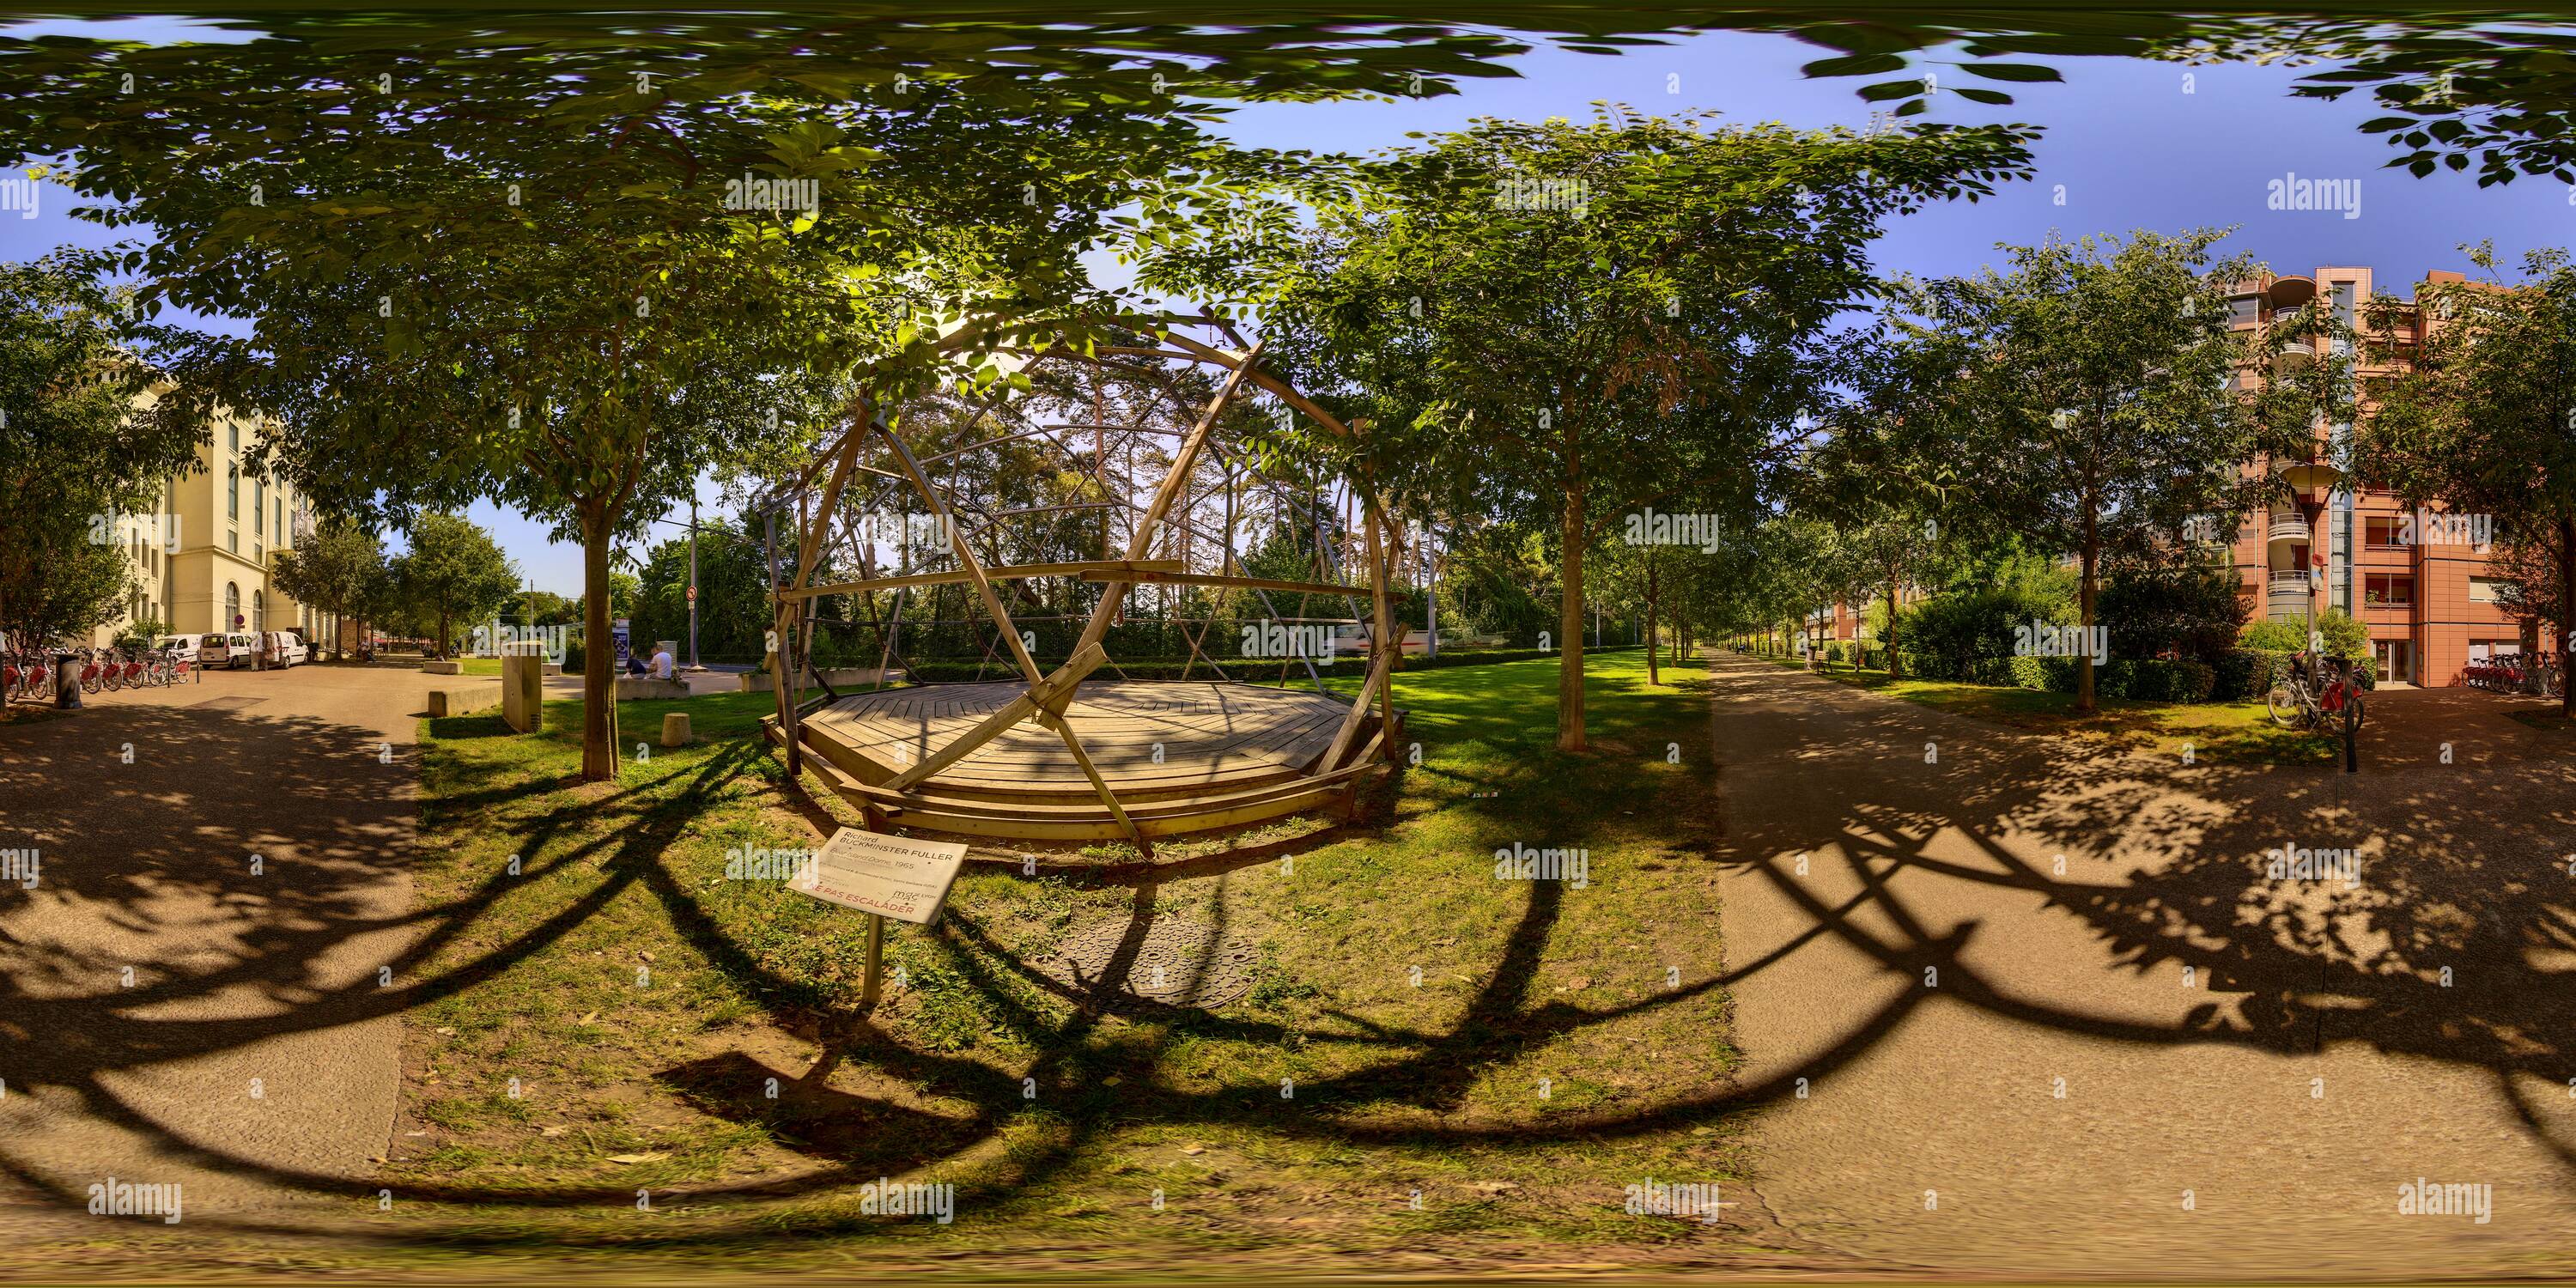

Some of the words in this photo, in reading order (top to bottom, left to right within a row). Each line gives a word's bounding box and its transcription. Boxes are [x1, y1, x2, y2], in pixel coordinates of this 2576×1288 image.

[843, 831, 879, 843] Richard
[839, 837, 909, 856] BUCKMINSTER
[910, 849, 954, 862] FULLER
[895, 860, 915, 870] 1965
[823, 887, 845, 899] PAS
[845, 893, 915, 915] ESCALADER
